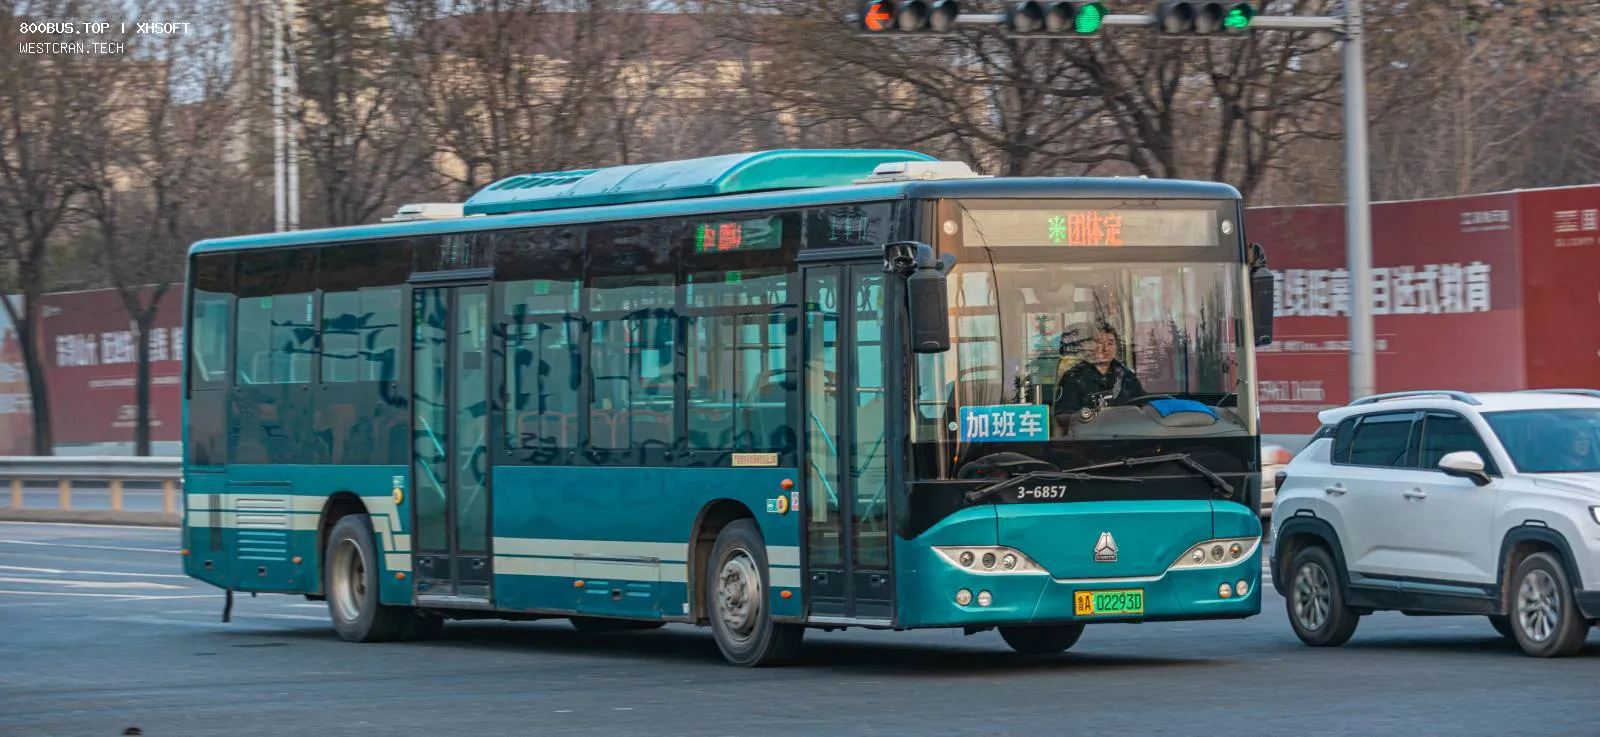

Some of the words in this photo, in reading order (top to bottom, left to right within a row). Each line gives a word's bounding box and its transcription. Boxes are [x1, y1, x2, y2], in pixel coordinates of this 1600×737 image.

[966, 411, 1043, 438] 加班车
[1017, 485, 1067, 499] 3-6857
